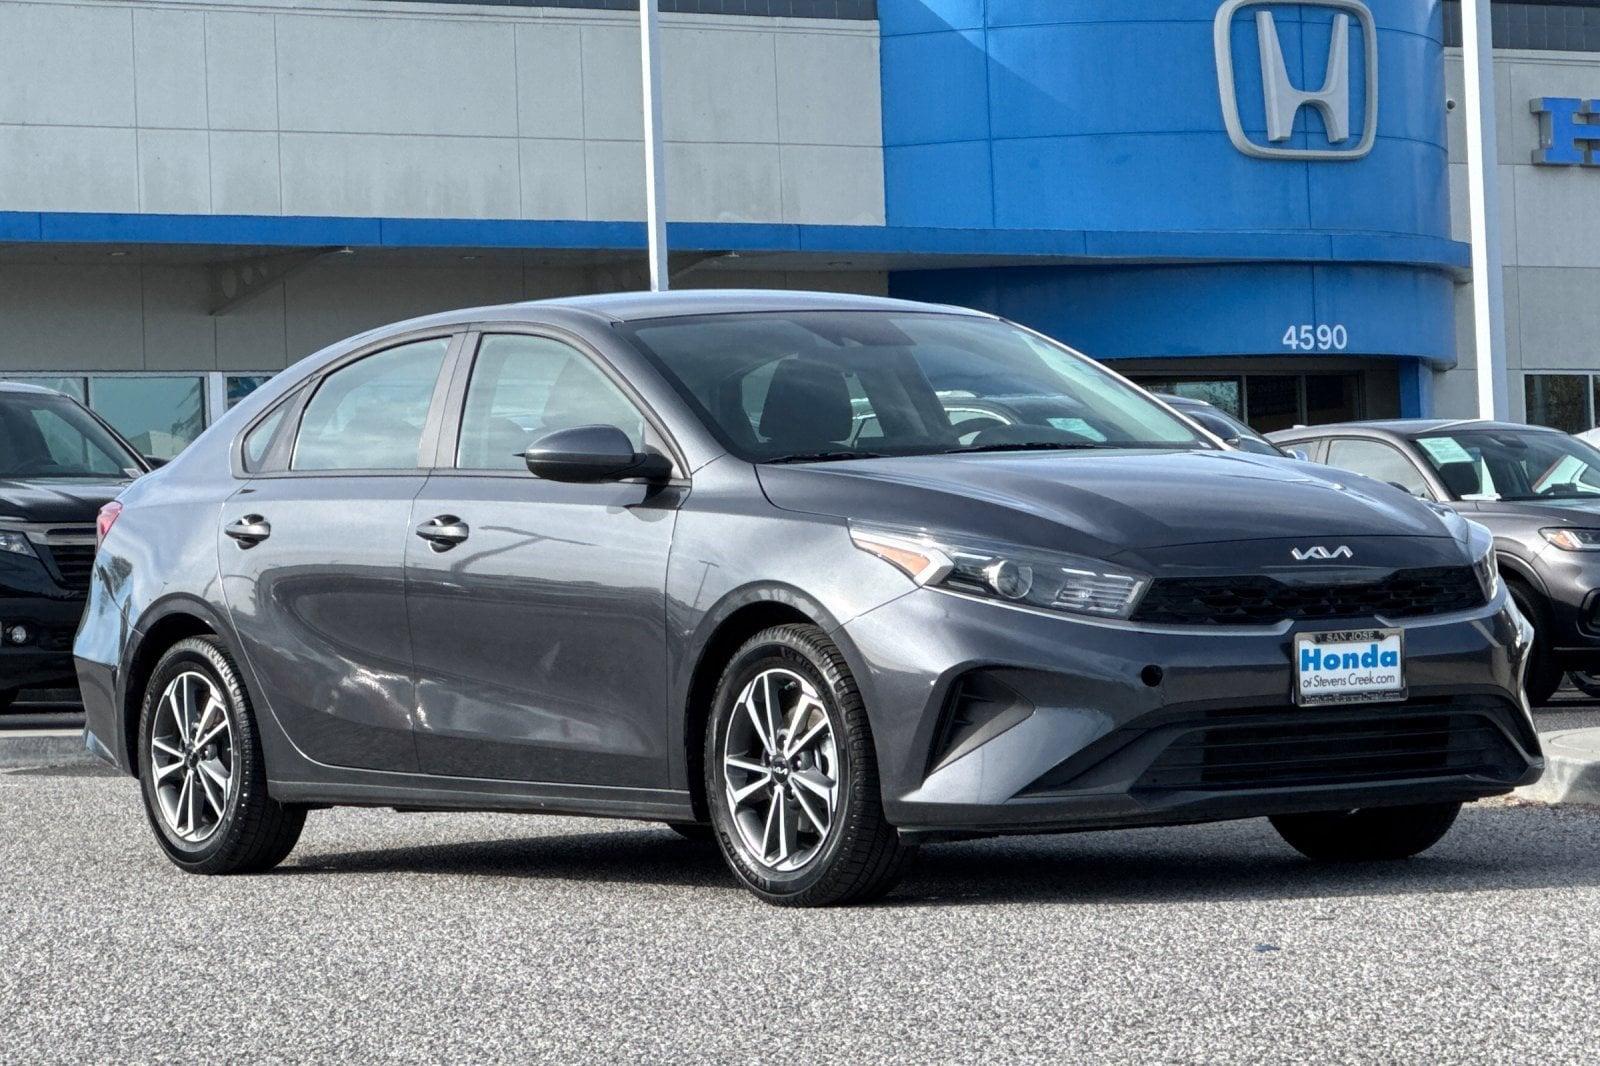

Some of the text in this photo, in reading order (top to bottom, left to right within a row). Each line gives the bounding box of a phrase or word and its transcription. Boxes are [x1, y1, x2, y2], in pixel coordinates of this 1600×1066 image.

[1282, 324, 1348, 350] 4590
[1326, 631, 1376, 642] SAN JOSE
[1301, 644, 1398, 672] Honda
[1302, 670, 1396, 689] of Stevens Creek.com
